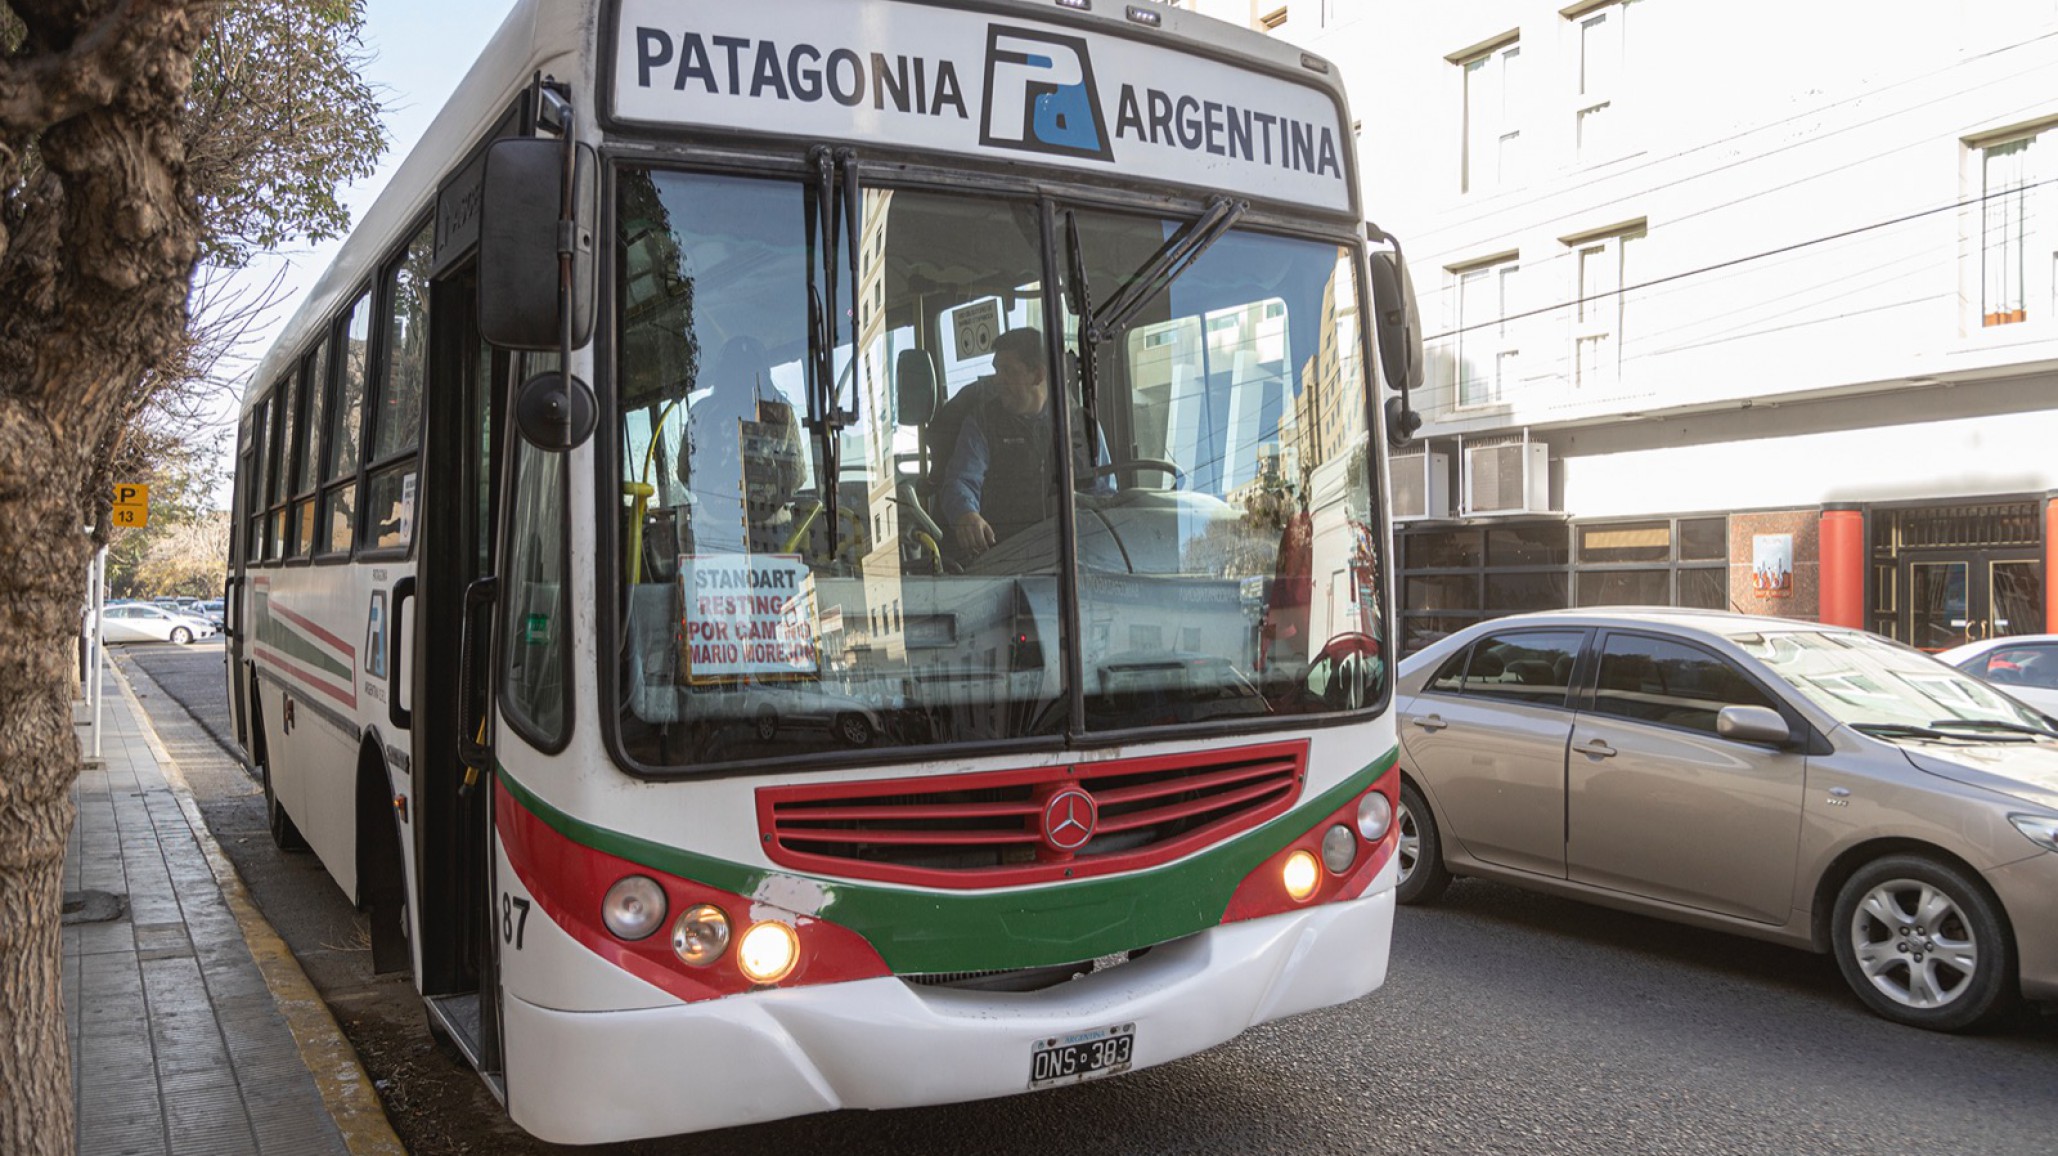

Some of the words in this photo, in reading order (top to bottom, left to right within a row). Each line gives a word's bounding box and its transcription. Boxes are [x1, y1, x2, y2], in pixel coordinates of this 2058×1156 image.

[636, 26, 969, 119] PATAGONIA
[1115, 83, 1341, 179] ARGENTINA
[118, 510, 134, 523] 13
[699, 595, 797, 616] RESTINGA
[688, 621, 729, 641] POR
[735, 620, 811, 641] CAMNO
[689, 644, 738, 664] MARIO
[502, 891, 531, 951] 87
[1090, 1037, 1131, 1069] 383
